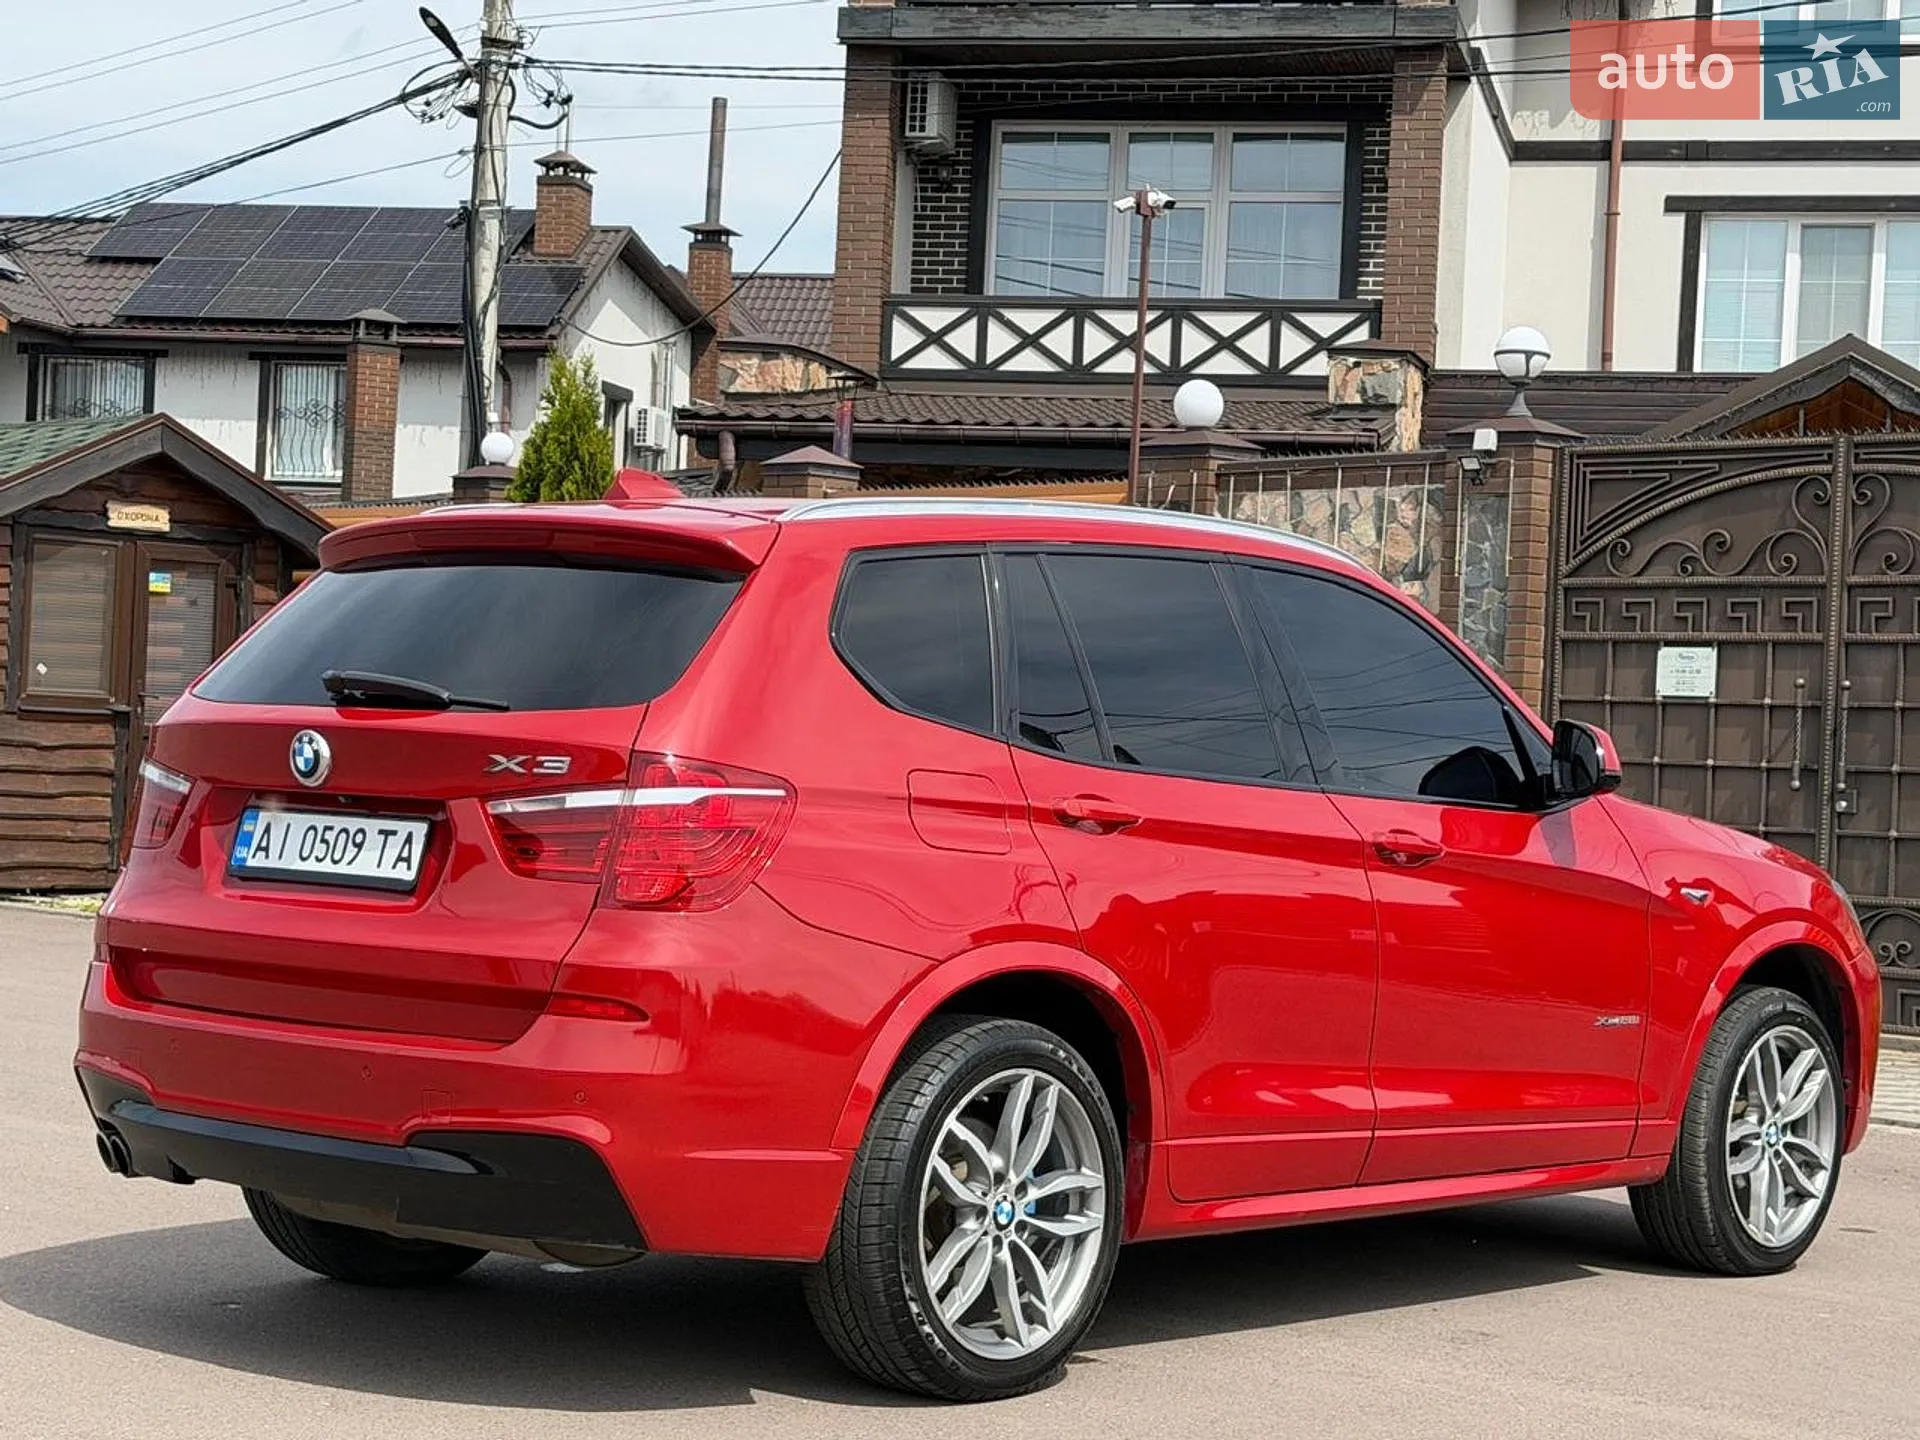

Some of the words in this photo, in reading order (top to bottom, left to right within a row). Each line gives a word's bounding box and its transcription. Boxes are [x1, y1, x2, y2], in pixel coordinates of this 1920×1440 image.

[482, 754, 572, 774] X3
[252, 822, 290, 859] AI
[298, 824, 367, 866] 0509
[376, 829, 415, 872] TA
